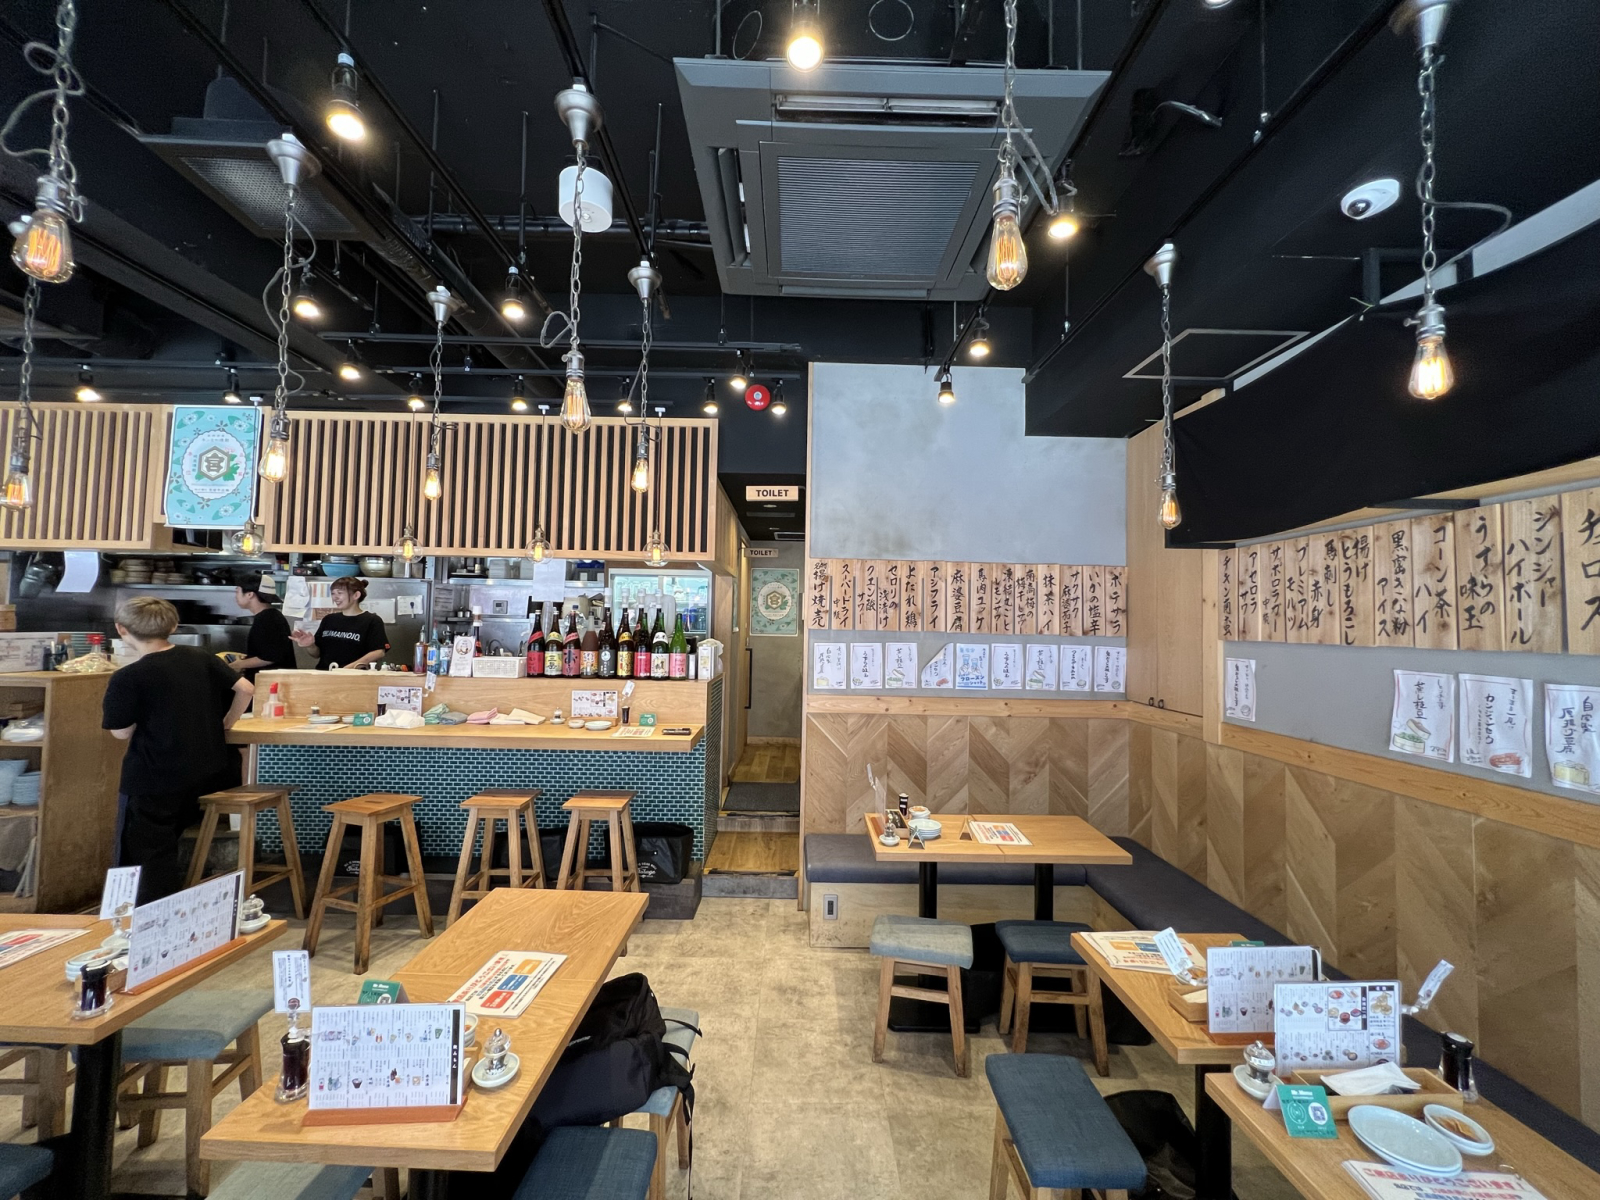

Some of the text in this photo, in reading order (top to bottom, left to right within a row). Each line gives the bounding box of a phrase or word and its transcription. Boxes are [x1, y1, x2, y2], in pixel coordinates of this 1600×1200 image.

[756, 489, 789, 497] TOILET
[888, 565, 899, 609] セロリの
[1249, 552, 1258, 614] アセロラ
[1296, 543, 1309, 631] プレミアム
[1323, 538, 1338, 608] 馬刺し
[1433, 526, 1452, 619] コーン茶
[1475, 515, 1495, 616] うずらの
[1532, 505, 1558, 608] ジンジャー
[840, 564, 852, 628] スーパードライ
[858, 592, 866, 625] サワー
[866, 565, 876, 612] クエン酸
[879, 589, 889, 628] 浅漬け
[905, 564, 918, 628] よだれ鶏
[949, 569, 965, 632] 麻婆豆腐
[976, 567, 987, 631] 馬肉ユッケ
[993, 577, 1001, 632] レモンサワー
[1025, 569, 1036, 618] 南高梅の
[1043, 573, 1056, 631] 抹茶ハイ
[1070, 571, 1080, 618] サクサク
[1089, 572, 1101, 636] いかの塩辛
[1110, 572, 1122, 634] ポテサラ
[1240, 591, 1248, 634] サワー
[1286, 577, 1298, 631] モルツ
[1310, 579, 1324, 629] 赤身
[1342, 541, 1356, 645] とうもろこし
[1377, 577, 1391, 638] アイス
[1415, 583, 1432, 634] ハイ
[1460, 572, 1484, 631] 味玉
[1506, 539, 1534, 644] ハイボール
